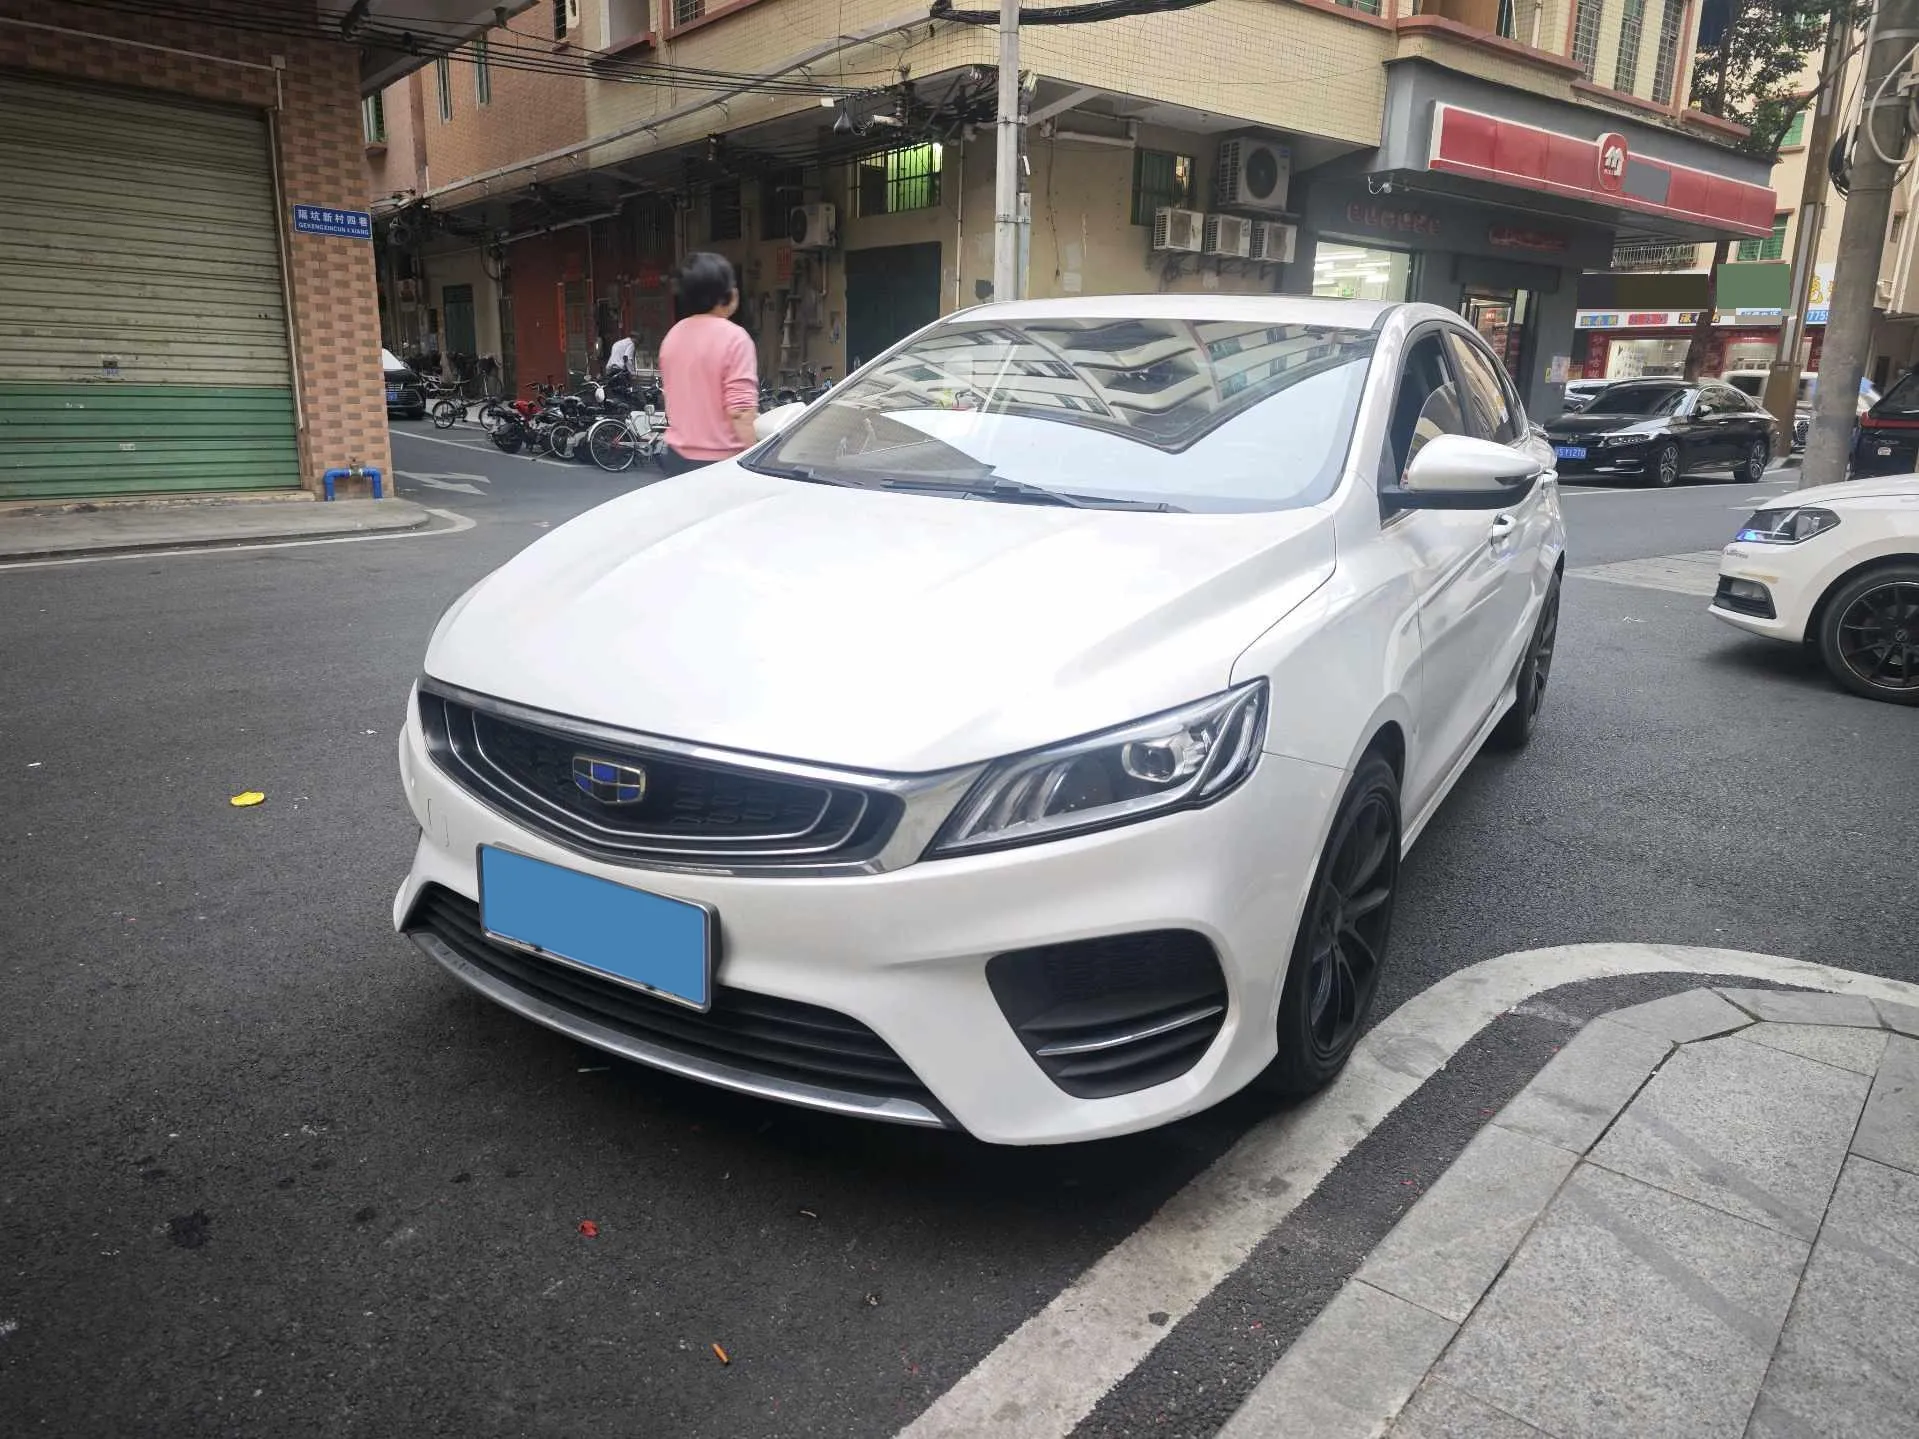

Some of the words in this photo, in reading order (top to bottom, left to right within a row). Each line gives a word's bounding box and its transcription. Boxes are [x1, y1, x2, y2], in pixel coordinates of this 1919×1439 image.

[297, 209, 368, 227] 隔坑新村四巷
